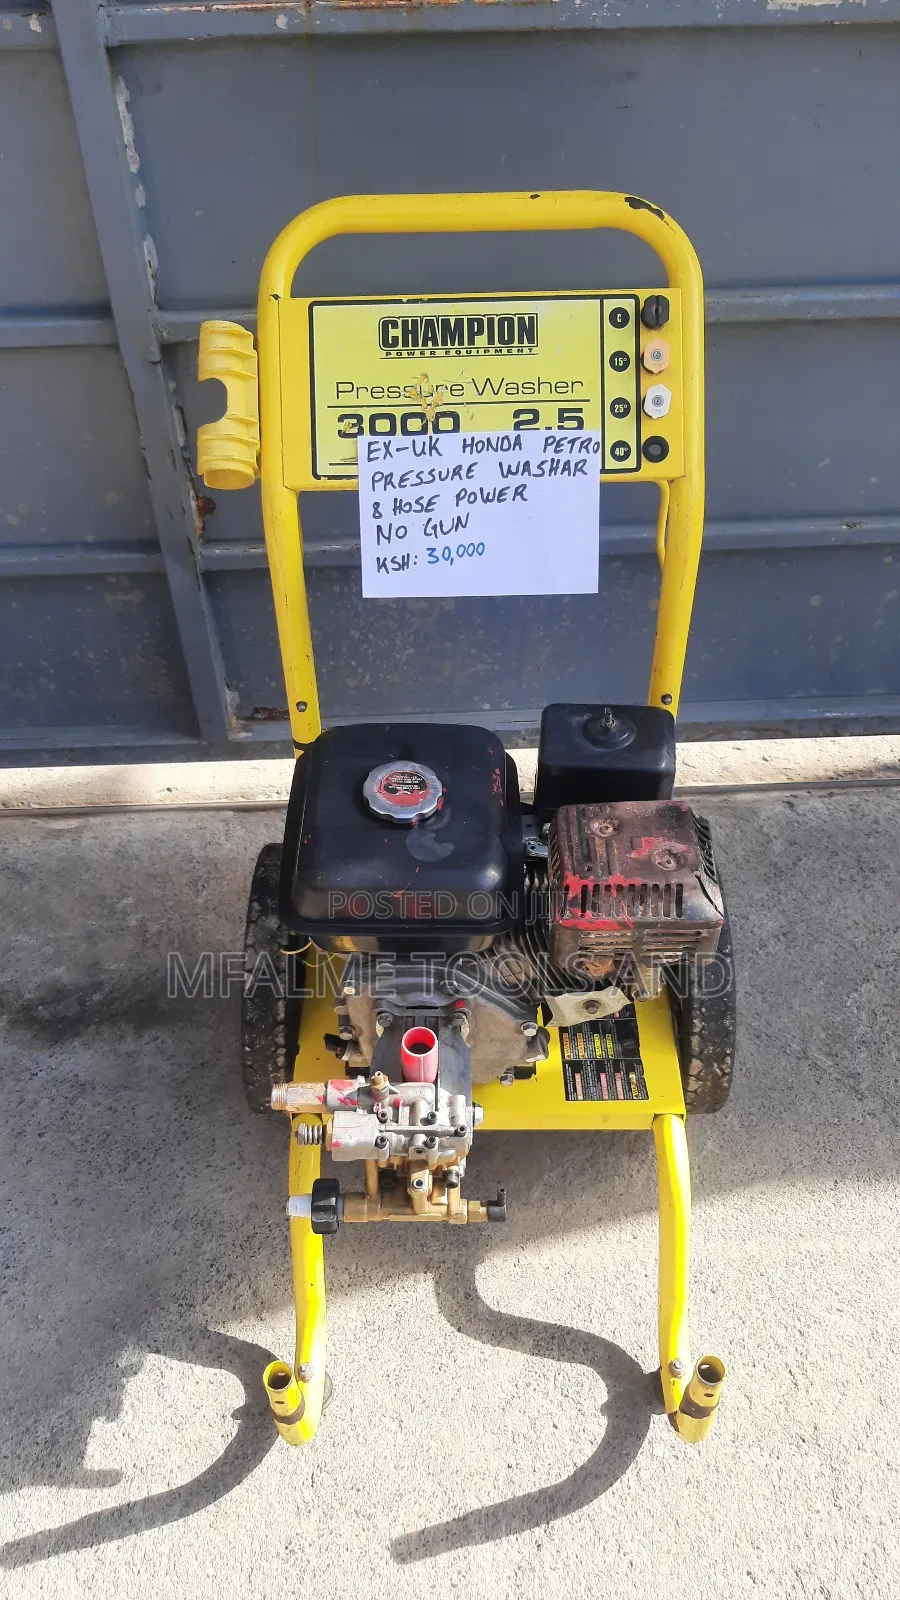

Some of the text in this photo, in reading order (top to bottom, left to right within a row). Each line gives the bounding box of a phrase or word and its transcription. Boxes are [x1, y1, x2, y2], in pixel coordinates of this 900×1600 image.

[380, 313, 538, 350] CHAMPION
[616, 313, 622, 323] C
[445, 347, 534, 356] EQUIPMENT
[614, 357, 628, 367] 15°
[336, 376, 584, 400] Pressure Washer
[337, 407, 585, 438] 3000 2.5
[614, 404, 628, 413] 25°
[367, 433, 600, 462] EX-UK HONDA PETRO
[614, 447, 629, 457] 40°
[371, 458, 588, 492] PRESSURE WASHAR
[392, 494, 440, 516] HOSE
[455, 483, 528, 508] POWER
[376, 512, 470, 546] NO GUN
[376, 541, 486, 574] KSH: 30,000
